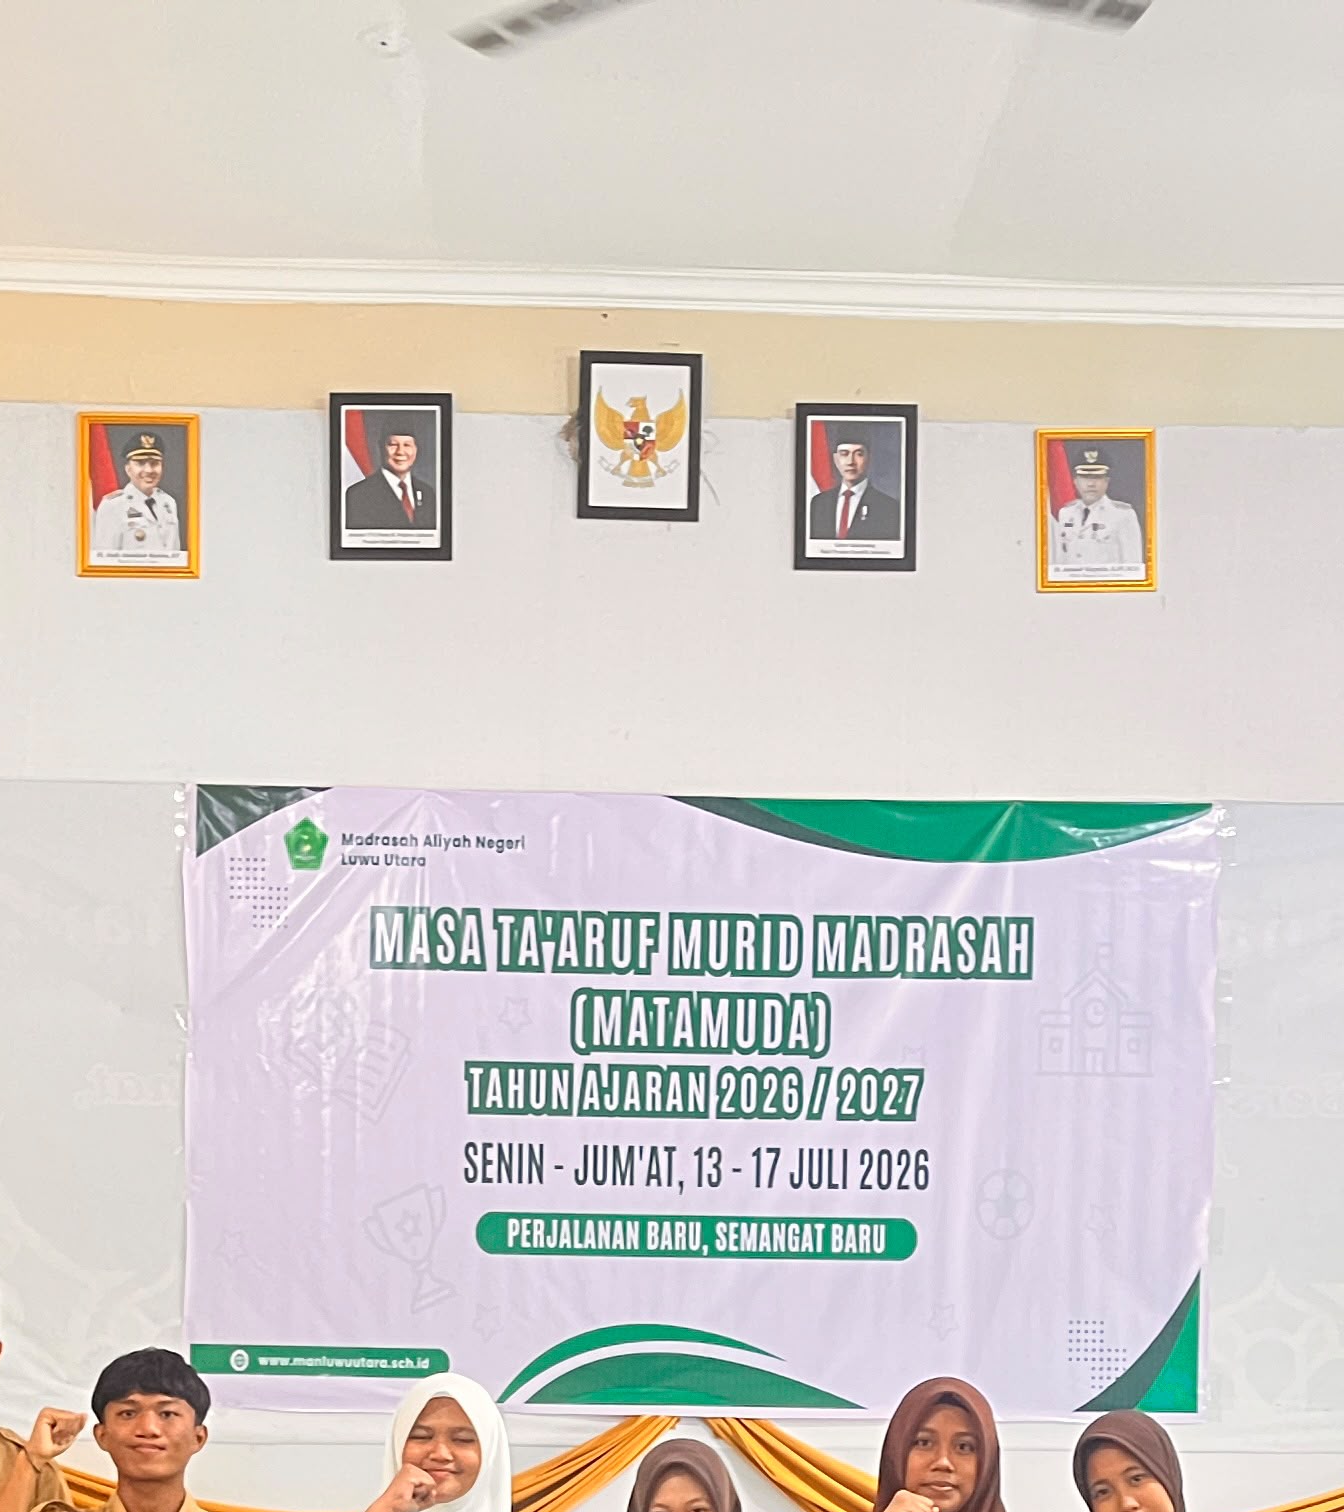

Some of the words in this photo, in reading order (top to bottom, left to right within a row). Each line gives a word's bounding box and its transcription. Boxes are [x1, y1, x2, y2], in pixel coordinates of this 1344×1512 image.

[341, 832, 418, 847] Madrasah
[423, 833, 471, 851] Aliyah
[475, 835, 526, 853] Negeri
[341, 853, 379, 866] Luwu
[384, 853, 426, 867] Utara
[374, 912, 483, 966] MASA
[497, 914, 657, 970] TA'ARUF
[672, 917, 800, 972] MURID
[816, 920, 1030, 975] MADRASAH
[573, 993, 827, 1054] (MATAMUDA)
[469, 1066, 570, 1112] TAHUN
[582, 1068, 706, 1114] AJARAN
[720, 1070, 801, 1115] 2026
[811, 1072, 828, 1115] /
[840, 1073, 921, 1117] 2027
[463, 1141, 545, 1186] SENIN
[573, 1144, 685, 1196] JUM'AT,
[692, 1145, 723, 1188] 13
[751, 1146, 782, 1189] 17
[788, 1148, 848, 1191] JULI
[858, 1148, 931, 1192] 2026
[506, 1217, 640, 1251] PERJALANAN
[645, 1220, 709, 1256] BARU,
[714, 1221, 826, 1254] SEMANGAT
[830, 1224, 887, 1255] BARU
[257, 1355, 431, 1370] www.manluwuutara.sch.id
